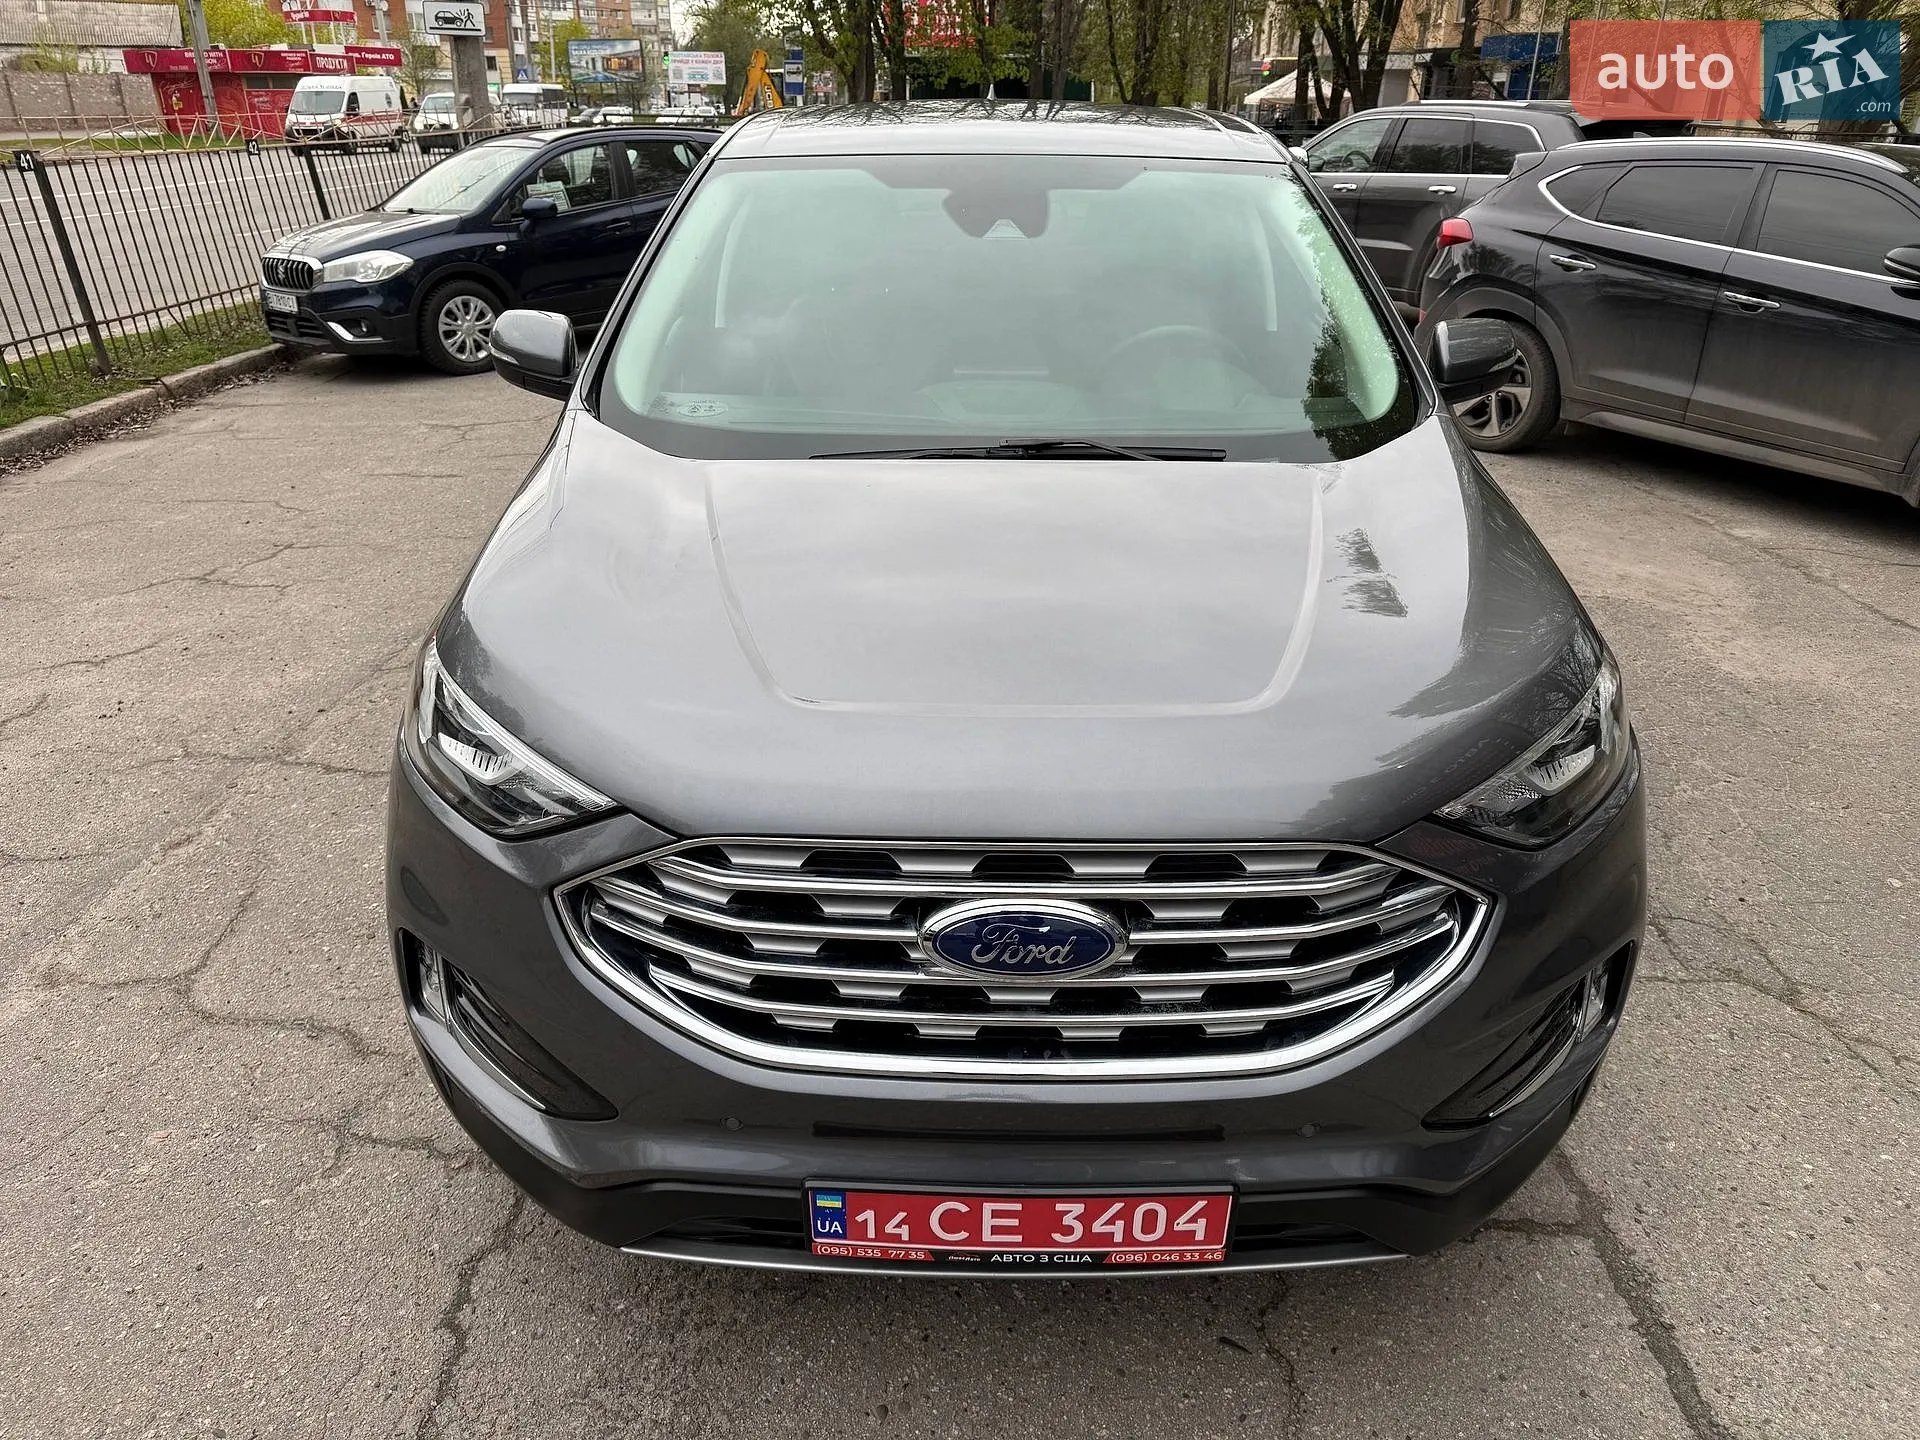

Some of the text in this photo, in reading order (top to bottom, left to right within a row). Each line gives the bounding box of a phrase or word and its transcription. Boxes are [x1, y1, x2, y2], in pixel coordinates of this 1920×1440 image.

[316, 56, 348, 69] ПРОДУКТИ
[248, 141, 259, 154] 42
[20, 153, 34, 170] 41
[970, 923, 1078, 965] Ford
[817, 1219, 843, 1234] UA
[855, 1200, 1208, 1244] 14 CE 3404
[817, 1244, 926, 1260] (095) 535 77 35
[991, 1253, 1035, 1263] АВТО
[1053, 1254, 1093, 1263] США
[1111, 1251, 1222, 1263] (096) 046 33 46
